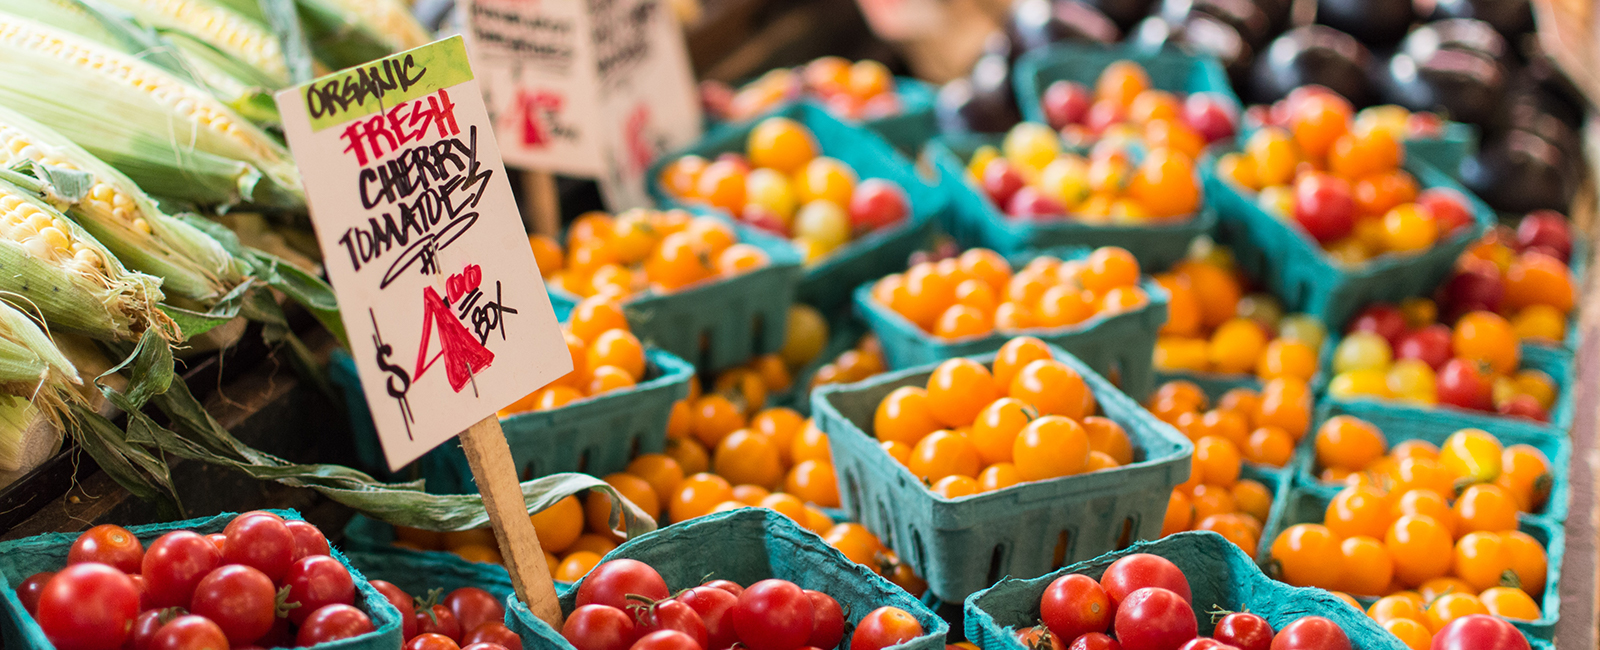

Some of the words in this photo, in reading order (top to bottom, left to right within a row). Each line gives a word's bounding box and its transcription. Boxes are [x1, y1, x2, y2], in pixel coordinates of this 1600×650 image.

[306, 54, 427, 119] ORGANIC
[339, 88, 461, 167] FRESH
[359, 125, 478, 210] CHERRY
[338, 164, 493, 272] TOMATOES
[471, 280, 518, 347] BOX
